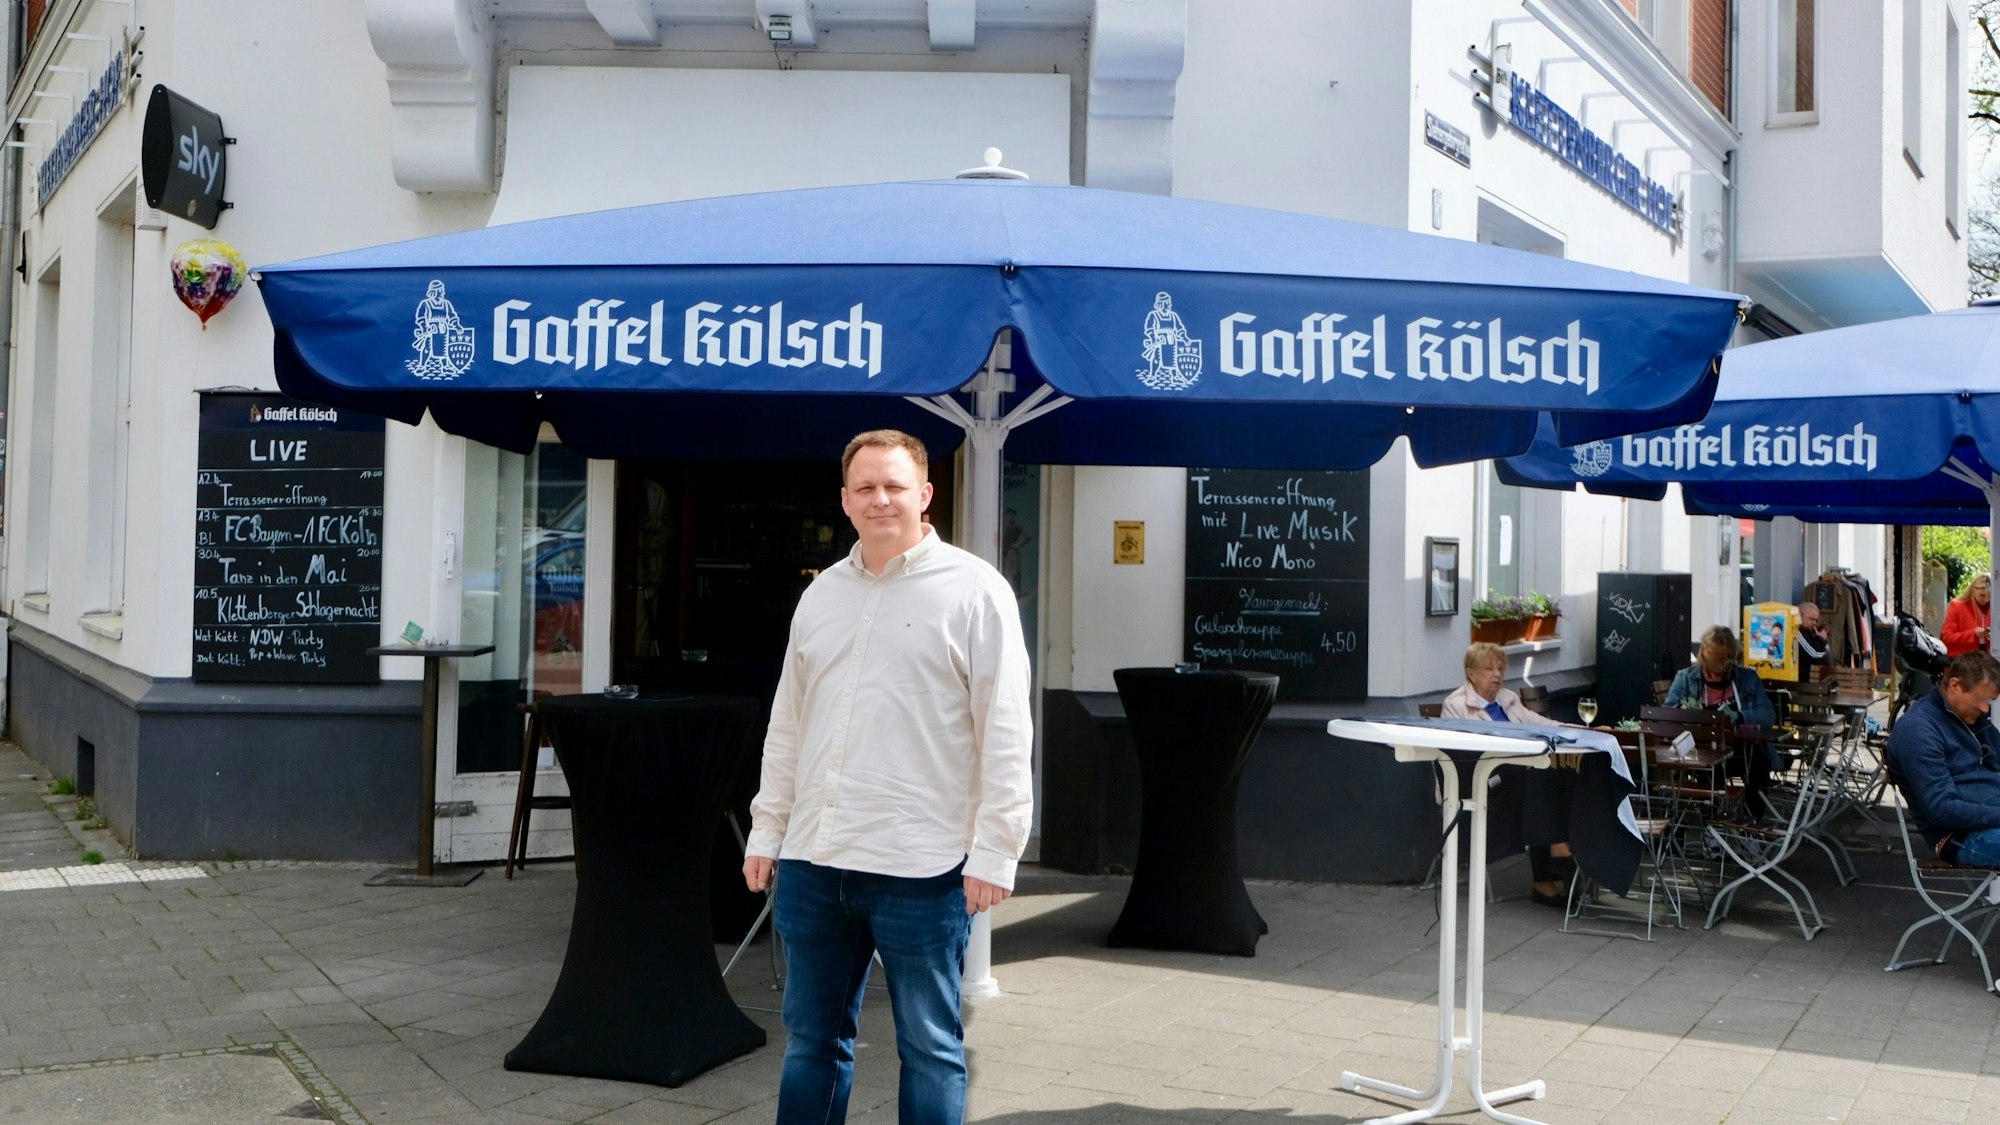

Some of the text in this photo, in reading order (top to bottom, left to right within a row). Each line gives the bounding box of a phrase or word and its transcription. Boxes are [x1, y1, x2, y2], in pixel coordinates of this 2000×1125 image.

[178, 126, 220, 194] sky
[493, 298, 883, 379] Gaffel Kölsch
[1220, 311, 1600, 396] Gaffel Kölsch
[263, 406, 338, 423] Gaffel Kölsch
[250, 439, 308, 461] LIVE
[1622, 422, 1877, 472] Gaffel Kölsch
[219, 483, 328, 507] Terrasseneröffnung
[1191, 476, 1337, 511] Terrasseneröffnung
[198, 532, 216, 545] BL
[225, 515, 250, 542] FC
[250, 514, 293, 552] Bayern
[340, 515, 377, 545] Köln
[1202, 511, 1228, 527] mit
[1240, 511, 1281, 540] Live
[219, 554, 347, 584] Tanz in den Mai
[217, 594, 296, 623] Klettenberger
[195, 629, 212, 642] Wat
[1320, 631, 1356, 653] 4,50
[196, 652, 214, 663] Dat
[300, 651, 327, 667] Party
